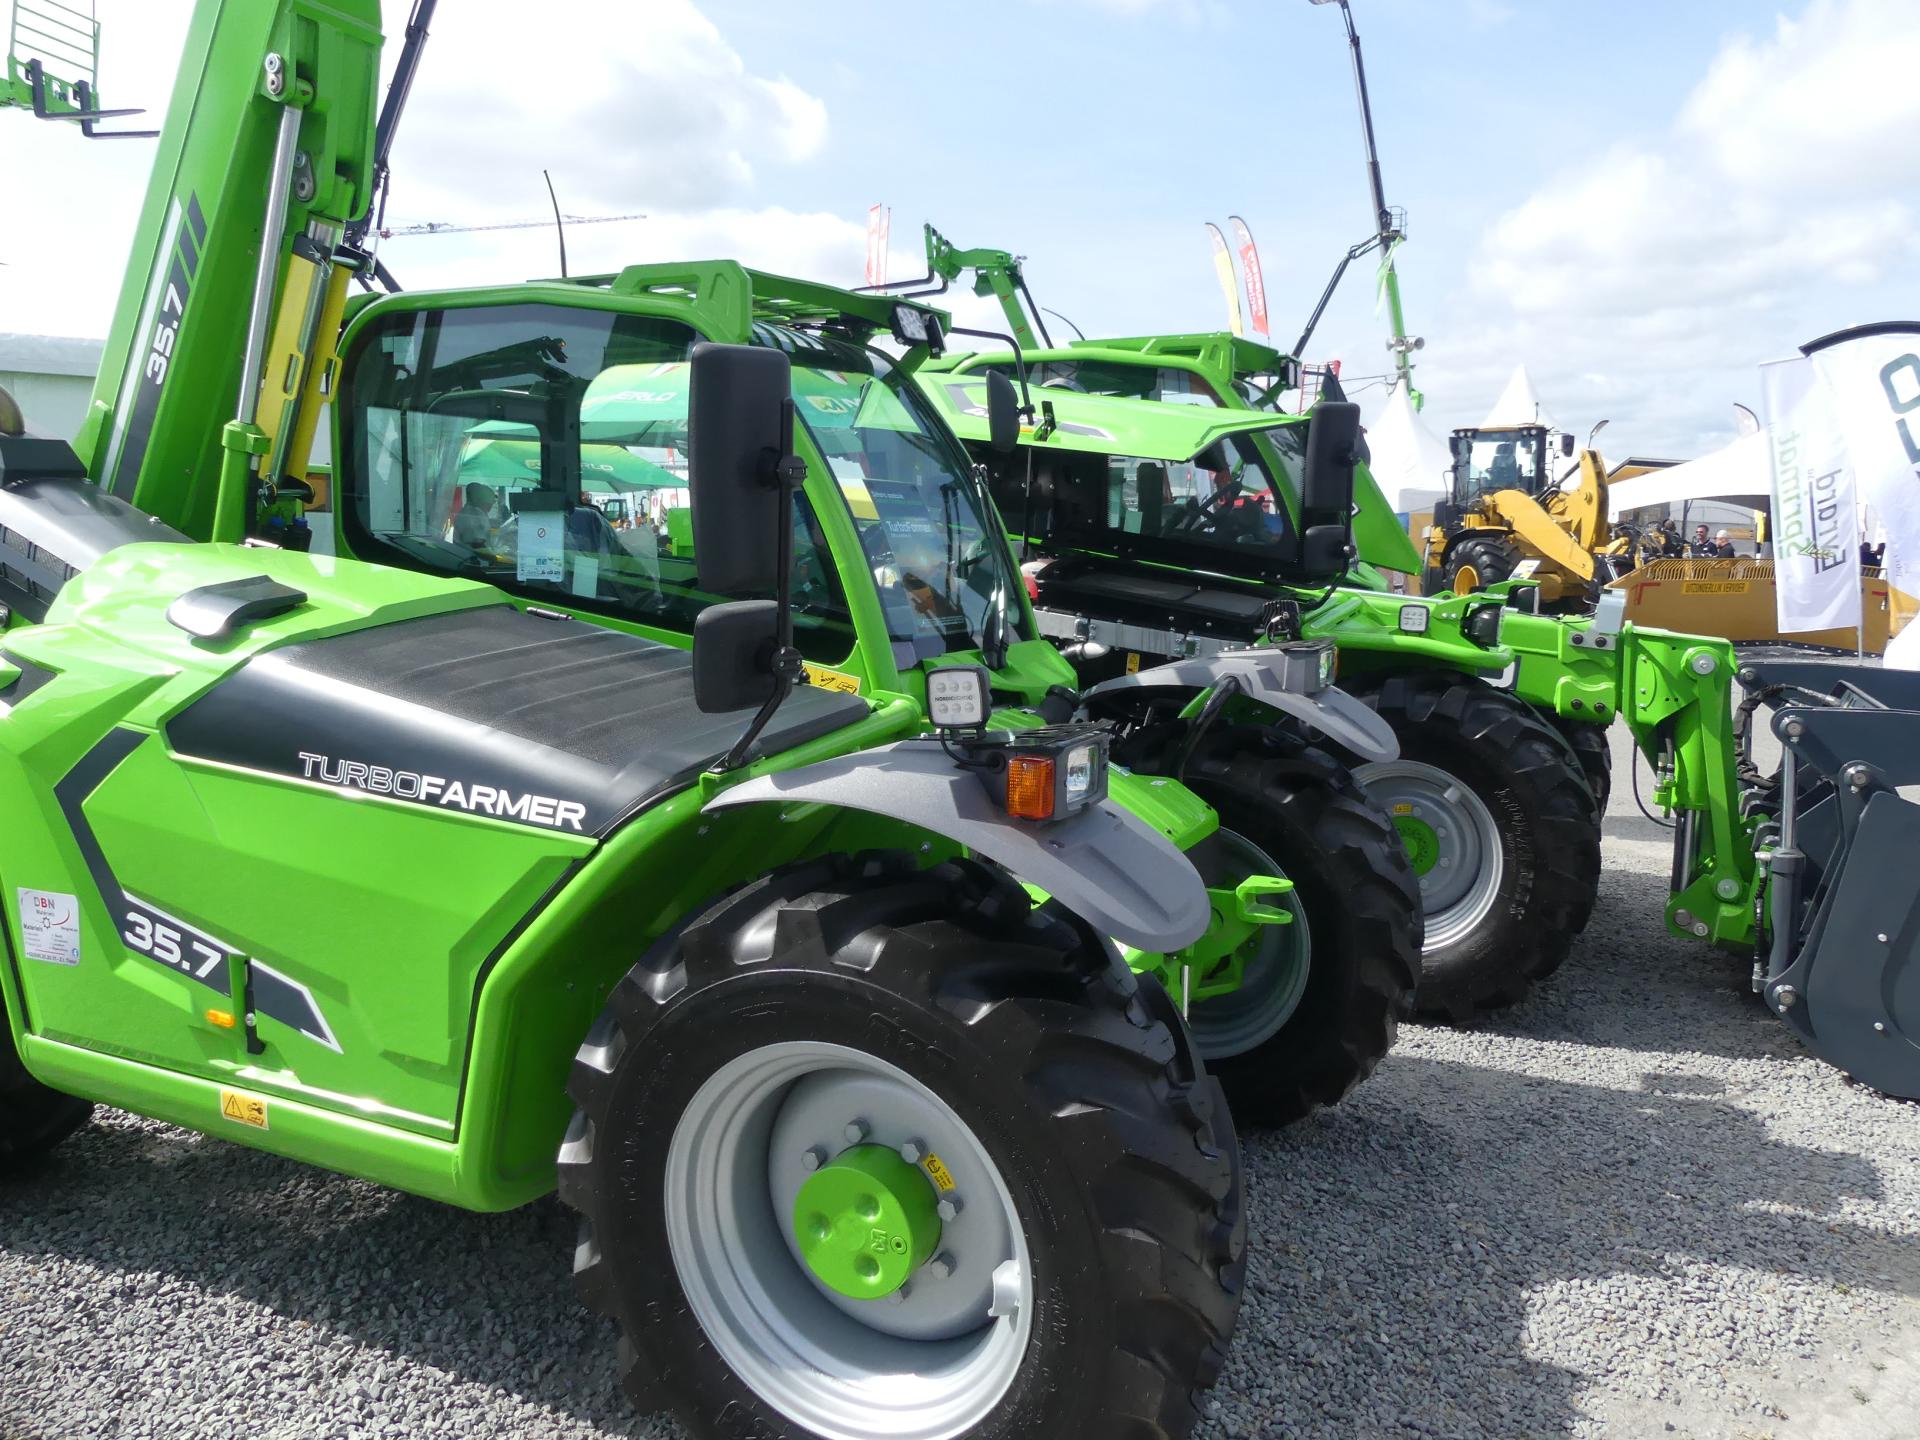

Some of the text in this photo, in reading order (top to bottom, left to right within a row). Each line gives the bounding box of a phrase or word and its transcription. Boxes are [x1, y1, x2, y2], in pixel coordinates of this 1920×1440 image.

[146, 282, 183, 385] 35.7
[299, 752, 587, 831] TURBOFARMER
[33, 896, 56, 910] DBN
[124, 911, 222, 978] 35.7
